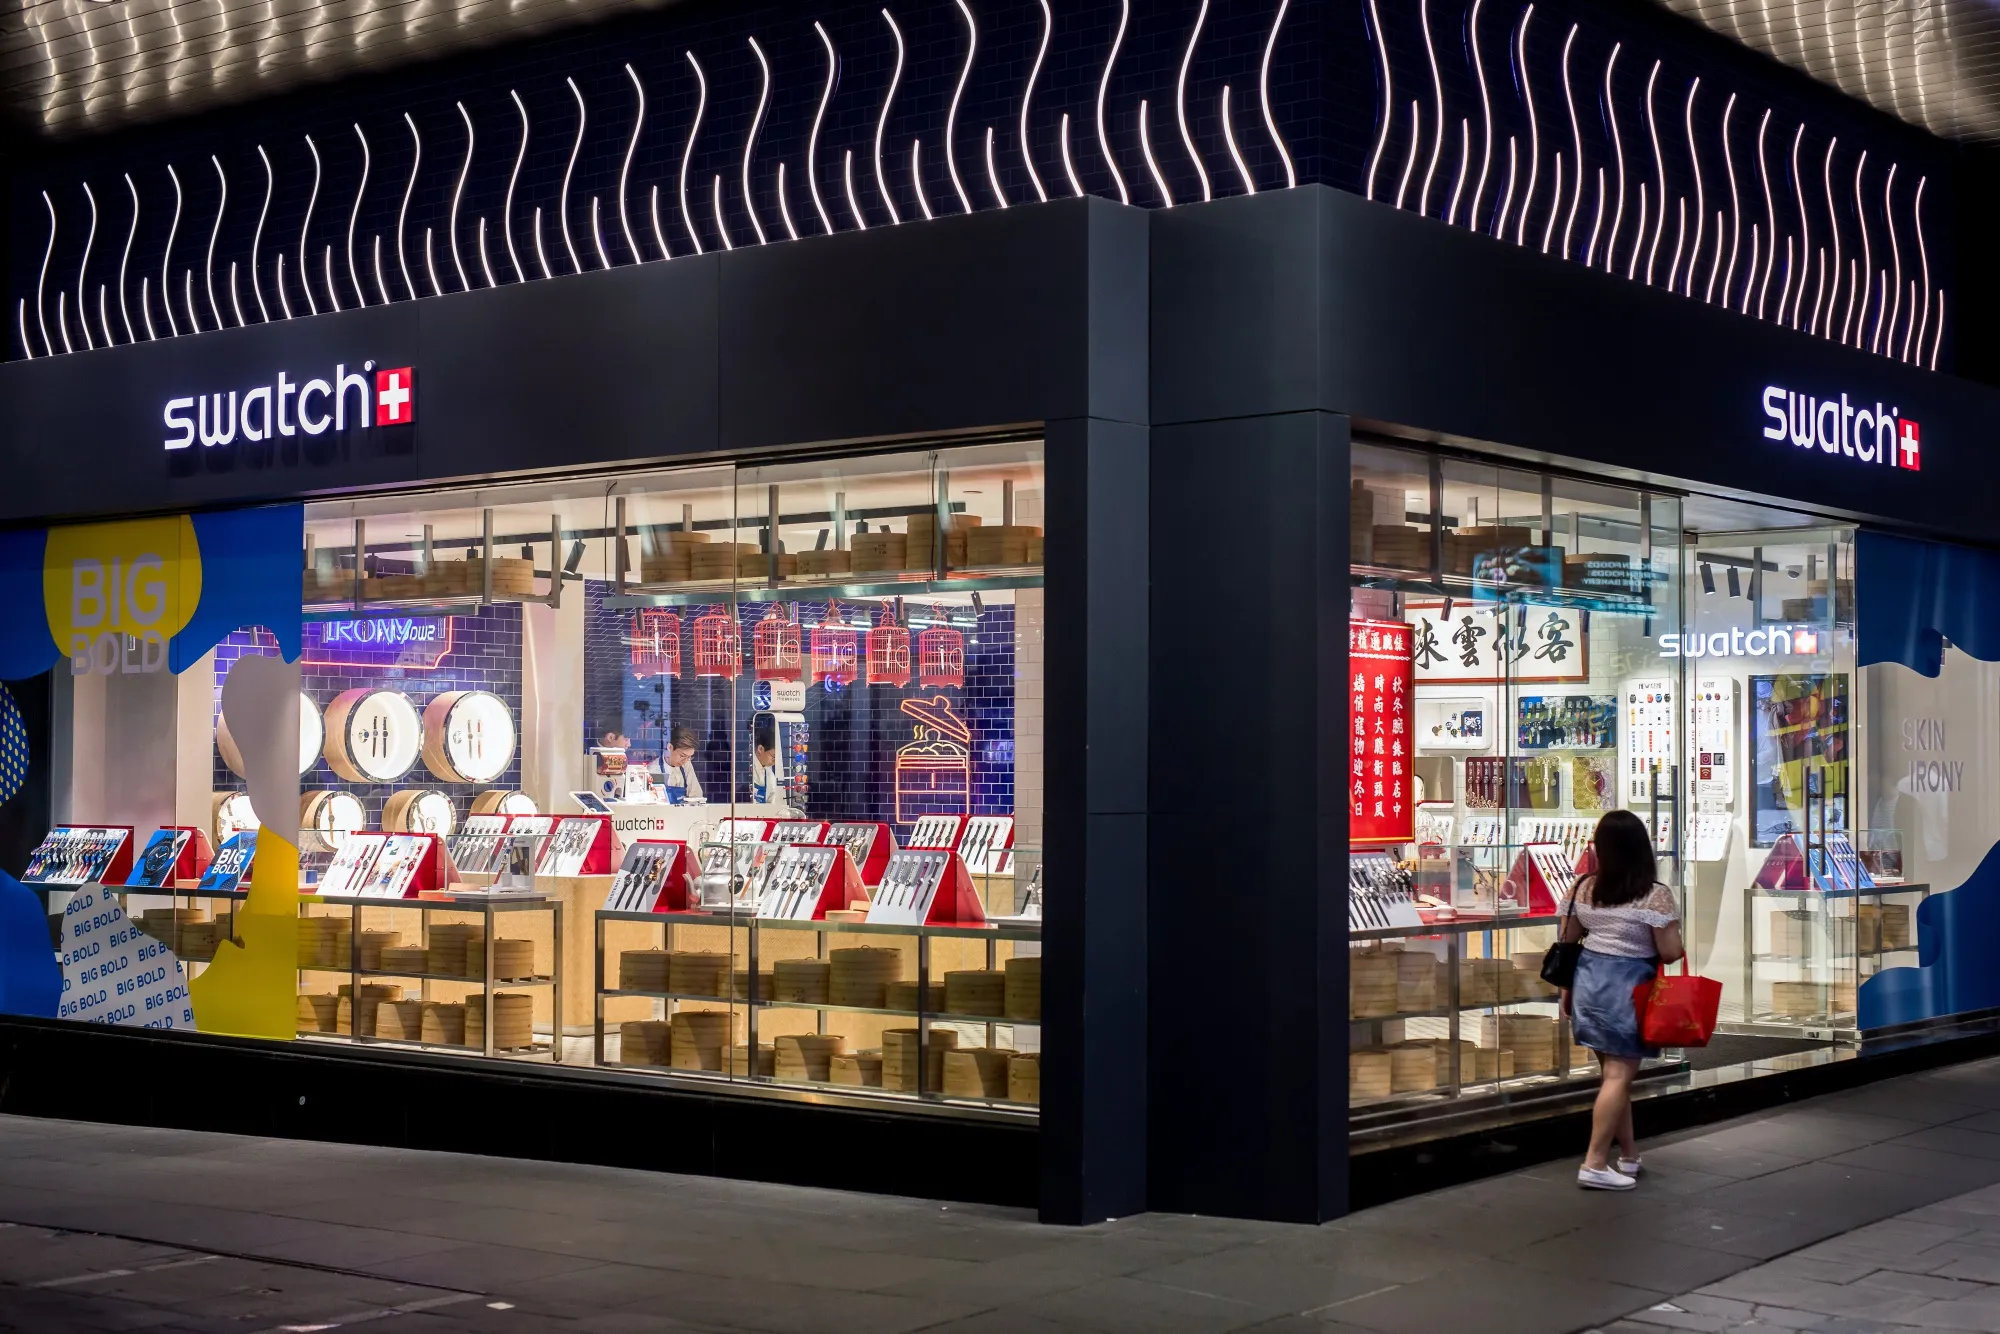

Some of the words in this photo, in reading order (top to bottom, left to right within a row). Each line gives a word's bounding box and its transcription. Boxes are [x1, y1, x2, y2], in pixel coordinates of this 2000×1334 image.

[163, 363, 370, 450] swatch
[1763, 385, 1898, 467] swatch
[71, 552, 167, 628] BIG
[70, 630, 165, 676] BOLD
[1658, 625, 1792, 657] swatch
[776, 689, 801, 697] swatch
[1902, 718, 1946, 751] SKIN
[1909, 760, 1965, 793] IRONY
[611, 817, 655, 831] watch
[211, 863, 240, 875] BOLD
[217, 848, 248, 865] BIG
[67, 895, 93, 915] BOLD
[103, 888, 113, 900] B
[74, 920, 91, 937] BIG
[94, 909, 121, 929] BOLD
[73, 942, 100, 963] BOLD
[110, 931, 127, 947] BIG
[81, 968, 98, 984] BIG
[101, 956, 128, 976] BOLD
[139, 945, 156, 962] BIG
[61, 1001, 77, 1017] BIG
[80, 990, 106, 1009] BOLD
[117, 981, 134, 996] BIG
[138, 967, 165, 988] BOLD
[108, 1005, 135, 1024] BOLD
[146, 994, 163, 1010] BIG
[166, 985, 190, 1002] BOL
